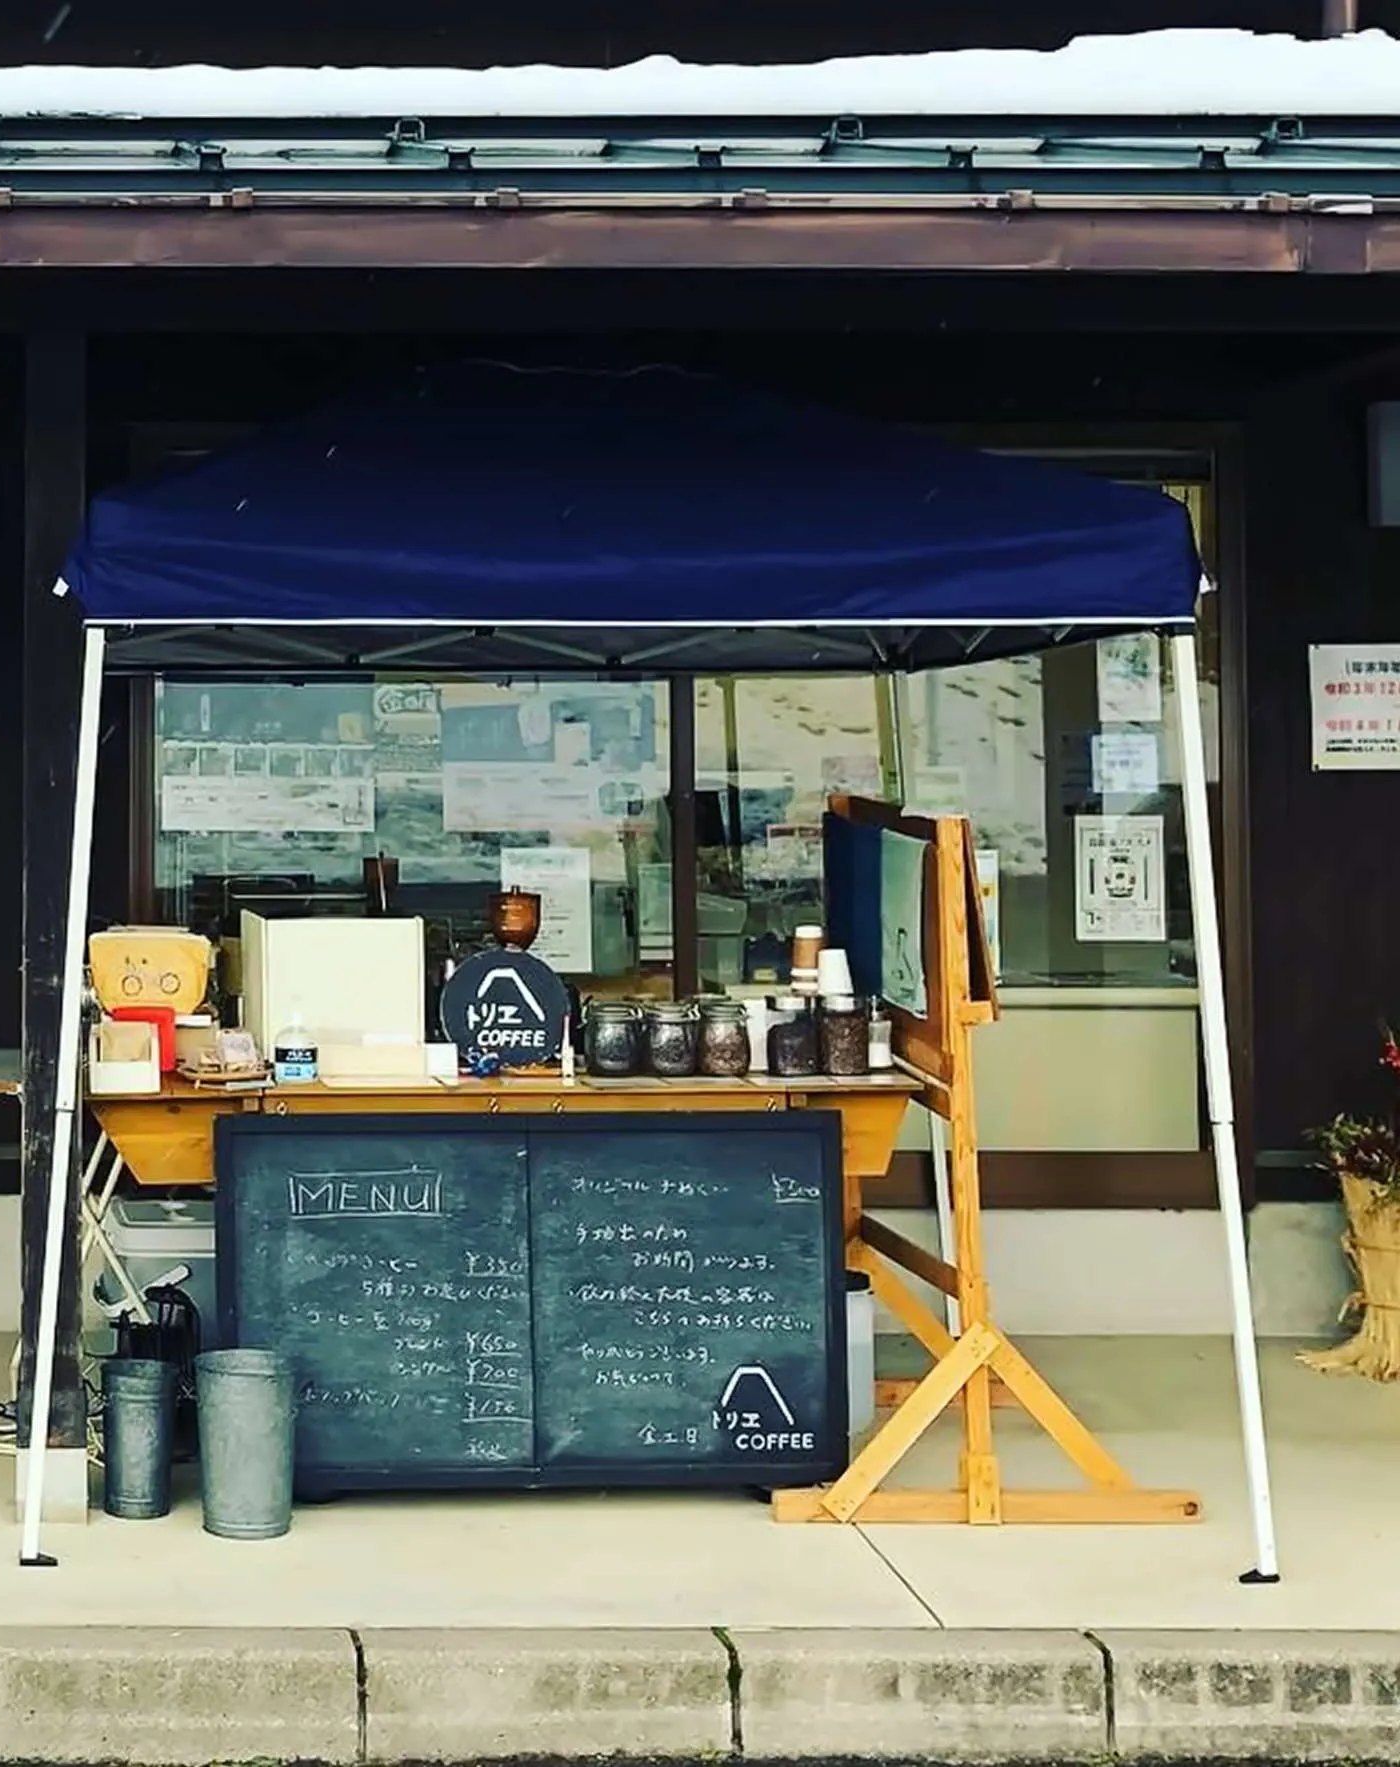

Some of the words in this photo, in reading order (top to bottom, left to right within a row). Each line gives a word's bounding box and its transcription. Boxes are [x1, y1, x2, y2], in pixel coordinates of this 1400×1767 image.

[477, 1029, 546, 1048] COFFEE
[299, 1182, 429, 1214] MENU
[466, 1331, 518, 1354] ¥650
[735, 1433, 815, 1450] COFFEE
